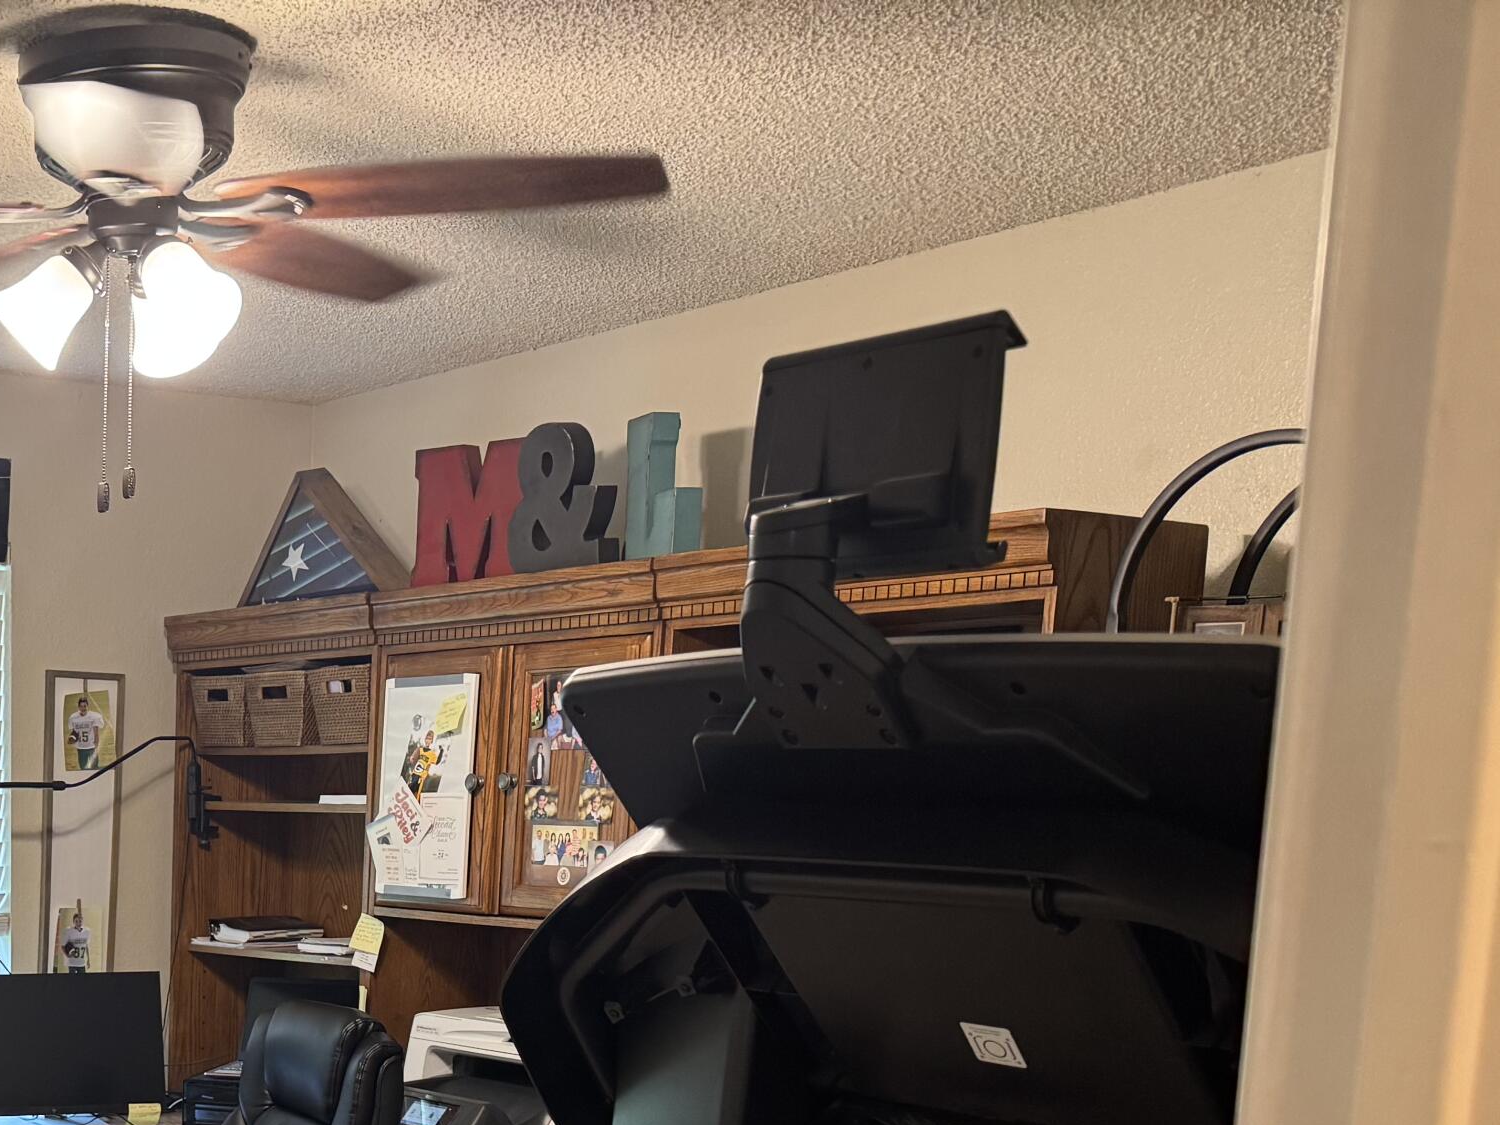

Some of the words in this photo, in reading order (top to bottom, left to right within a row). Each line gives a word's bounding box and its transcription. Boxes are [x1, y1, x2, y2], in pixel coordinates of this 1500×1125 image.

[410, 436, 526, 588] M
[508, 421, 619, 573] &
[625, 412, 704, 561] L
